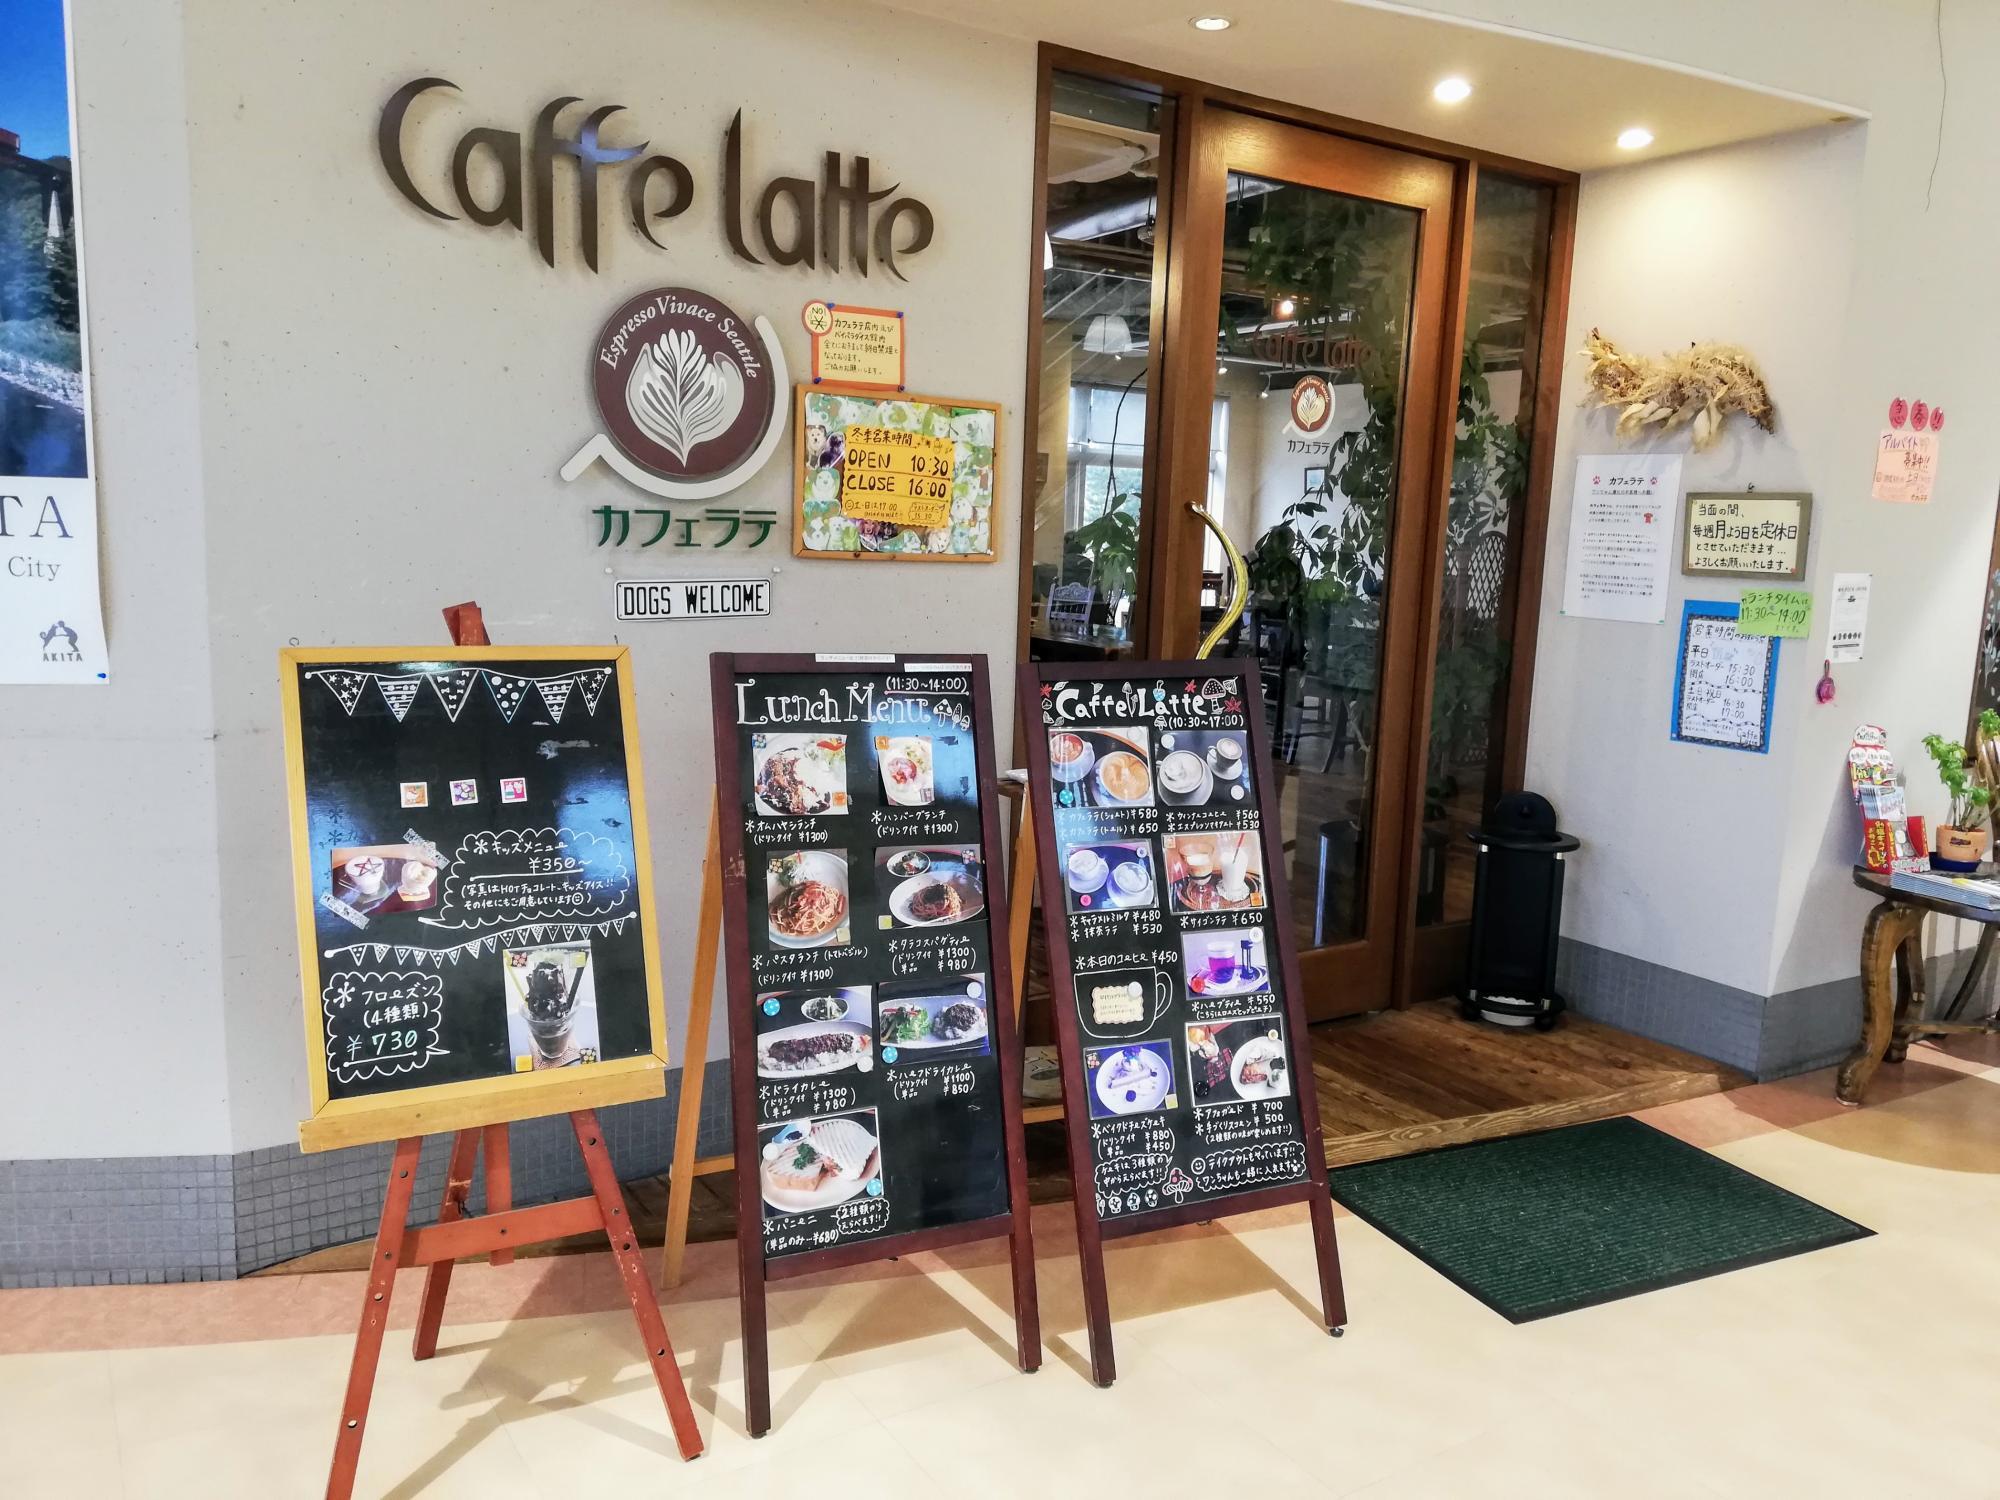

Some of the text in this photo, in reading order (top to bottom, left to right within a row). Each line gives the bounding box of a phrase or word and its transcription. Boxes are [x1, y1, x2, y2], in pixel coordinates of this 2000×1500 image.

[377, 76, 935, 282] Caffe latte
[600, 294, 761, 379] Espresso Vivace Seattle
[1287, 440, 1330, 455] カフェラテ
[848, 448, 949, 477] OPEN 10:30
[846, 474, 947, 498] CLOSE 16:00
[1608, 476, 1645, 486] カフェラテ
[592, 505, 777, 549] カフェラテ
[1692, 519, 1798, 541] 毎週月よう日を定休日
[8, 555, 62, 582] City
[623, 583, 765, 616] DOGS WELCOME
[43, 652, 83, 662] AKITA
[1724, 674, 1755, 688] 16:00
[1728, 663, 1755, 676] 15:30
[734, 678, 931, 725] Lunch Menu
[1056, 687, 1208, 721] Caffe Latte
[756, 817, 817, 831] オムハヤシランチ
[491, 838, 569, 856] キッズメニュー
